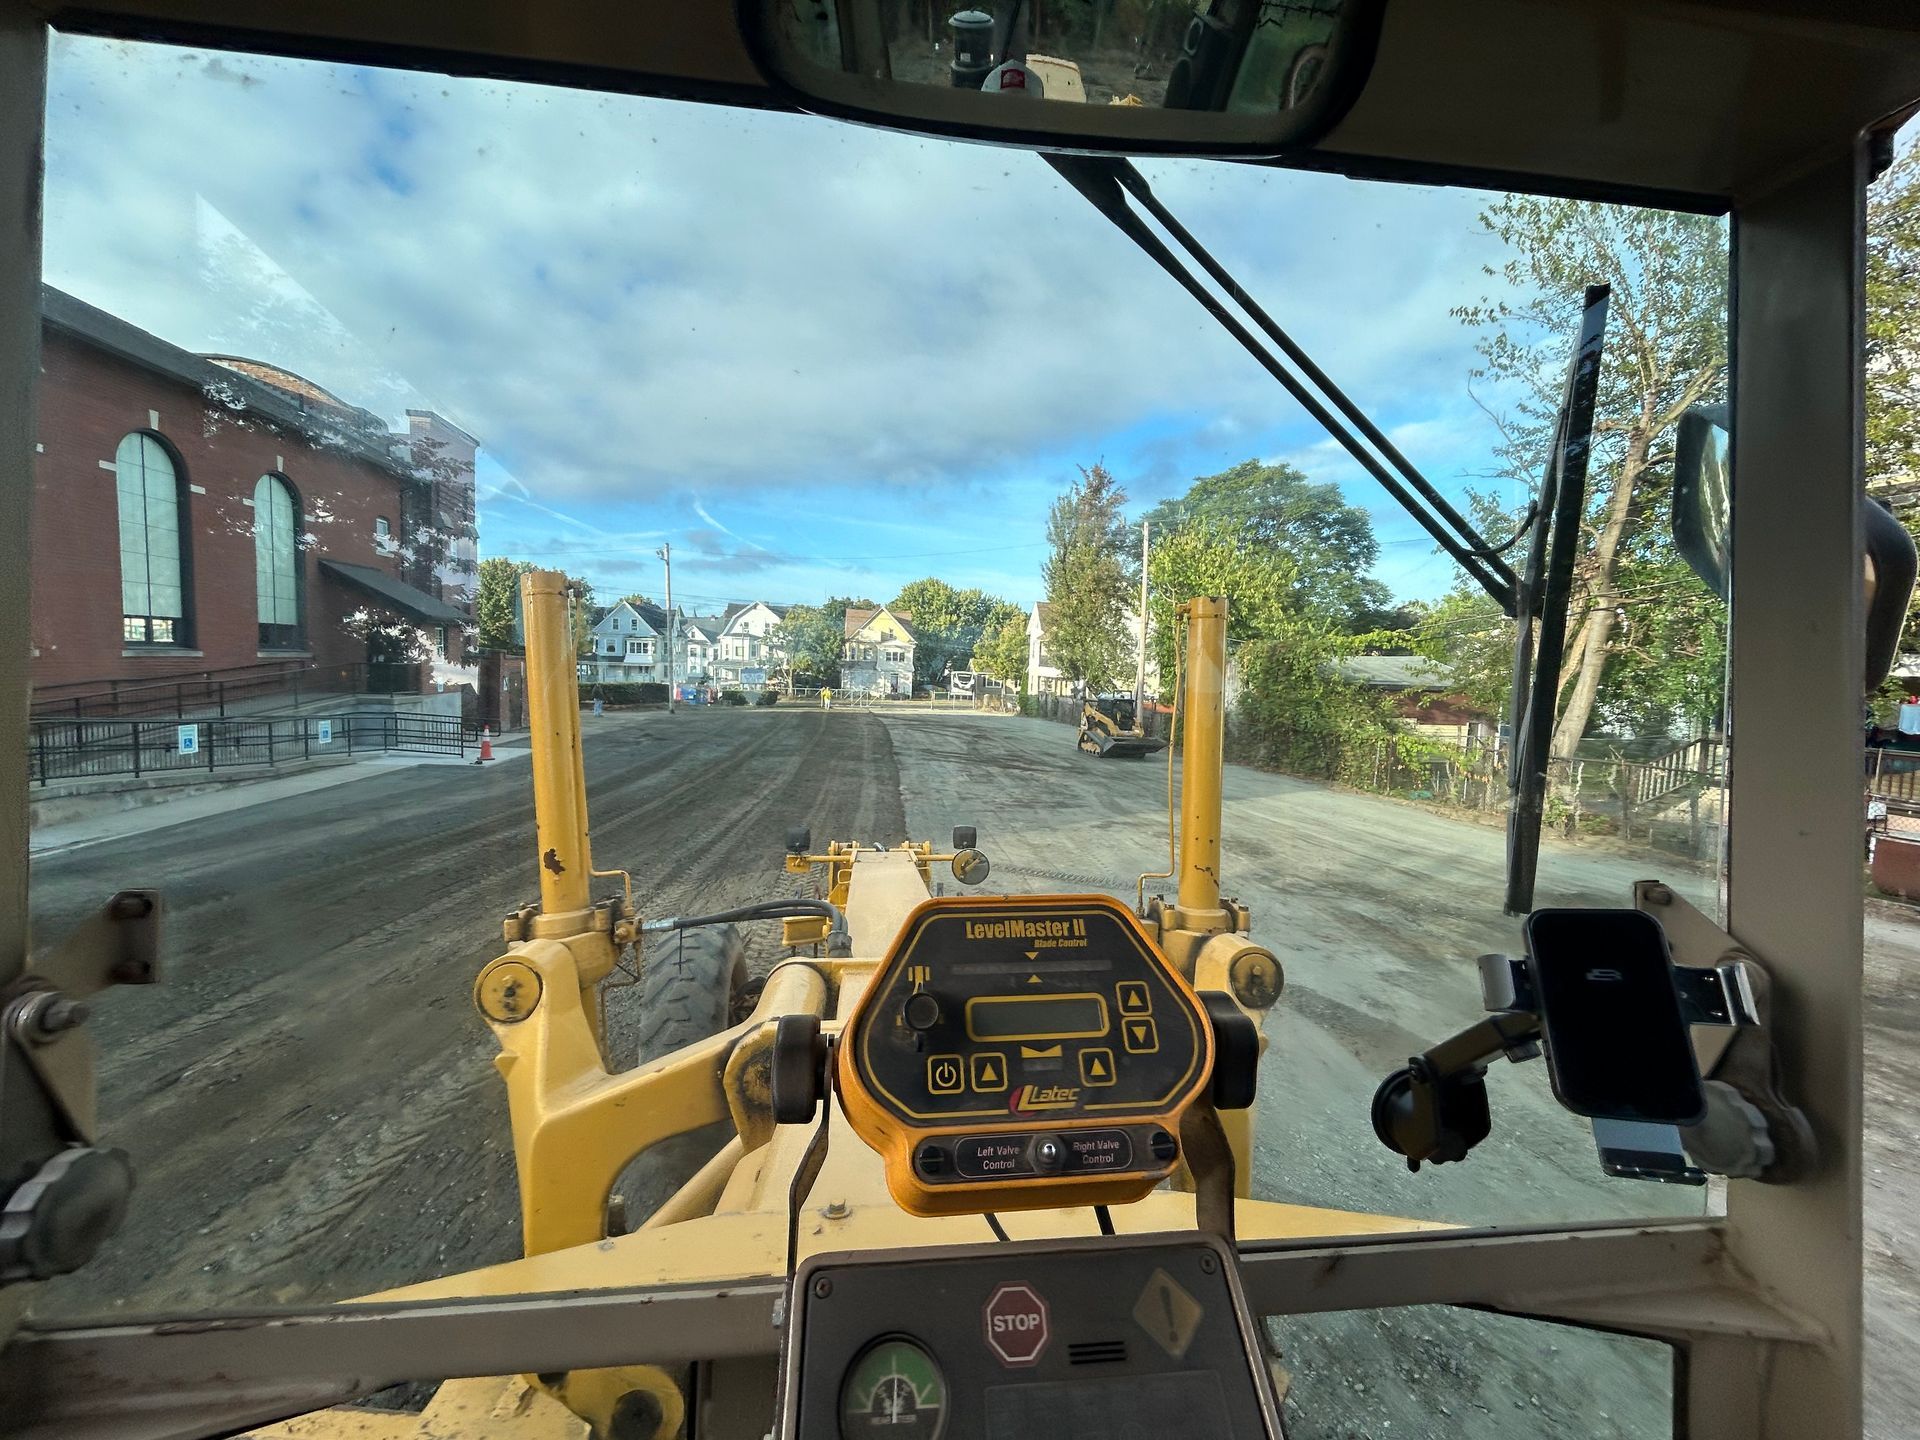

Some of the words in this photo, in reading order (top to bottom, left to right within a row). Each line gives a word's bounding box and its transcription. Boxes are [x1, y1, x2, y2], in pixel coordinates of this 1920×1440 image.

[965, 920, 1070, 939] LevelMaster
[1072, 918, 1086, 936] II
[1034, 939, 1057, 948] Blade
[1058, 938, 1088, 948] Control
[1029, 1085, 1081, 1103] Latec
[977, 1145, 995, 1157] Left
[996, 1145, 1019, 1156] Valve
[1073, 1141, 1096, 1153] Right
[1097, 1140, 1120, 1150] Valve
[982, 1158, 1015, 1171] Control
[1082, 1152, 1114, 1164] Control
[993, 1313, 1040, 1332] STOP
